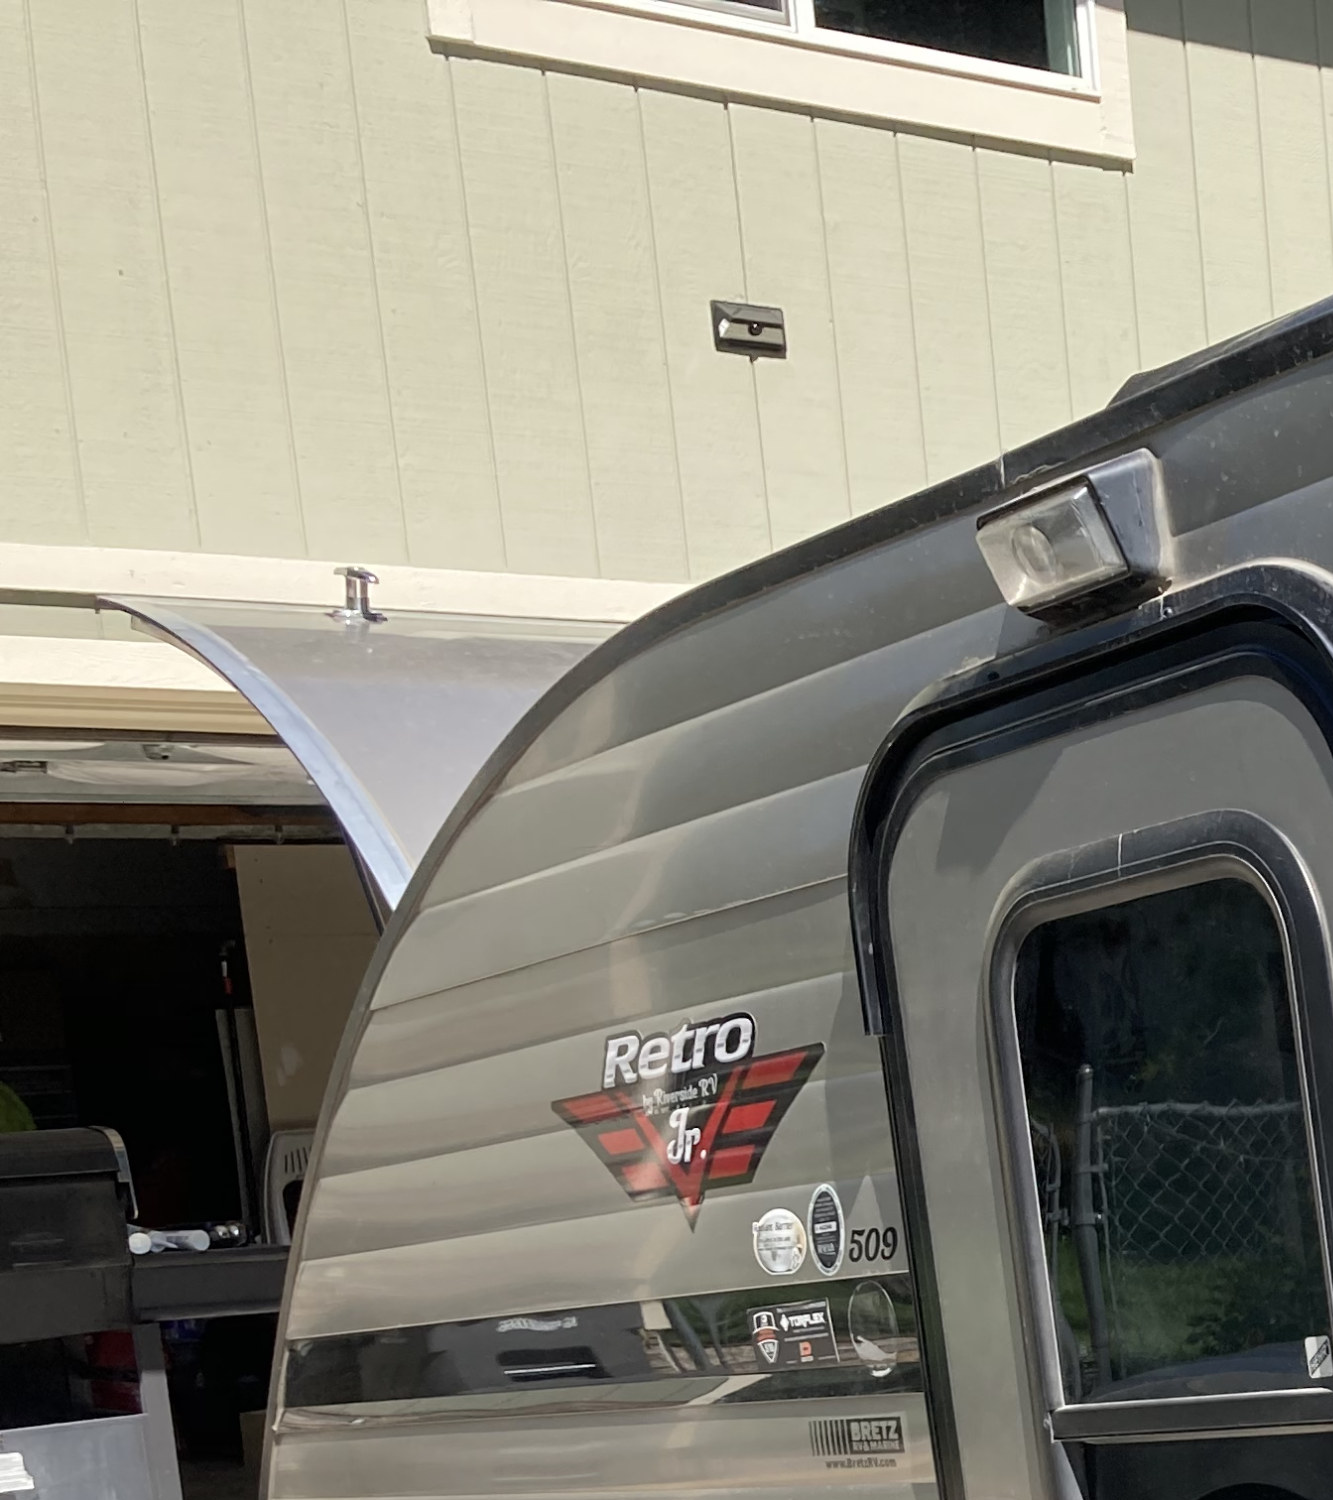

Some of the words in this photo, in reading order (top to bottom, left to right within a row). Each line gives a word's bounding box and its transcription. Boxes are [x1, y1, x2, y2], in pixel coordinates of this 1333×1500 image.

[603, 1017, 753, 1089] Retro
[653, 1085, 699, 1105] Riverside
[698, 1072, 718, 1097] RV
[849, 1227, 898, 1263] 509
[850, 1420, 899, 1440] BRETZ
